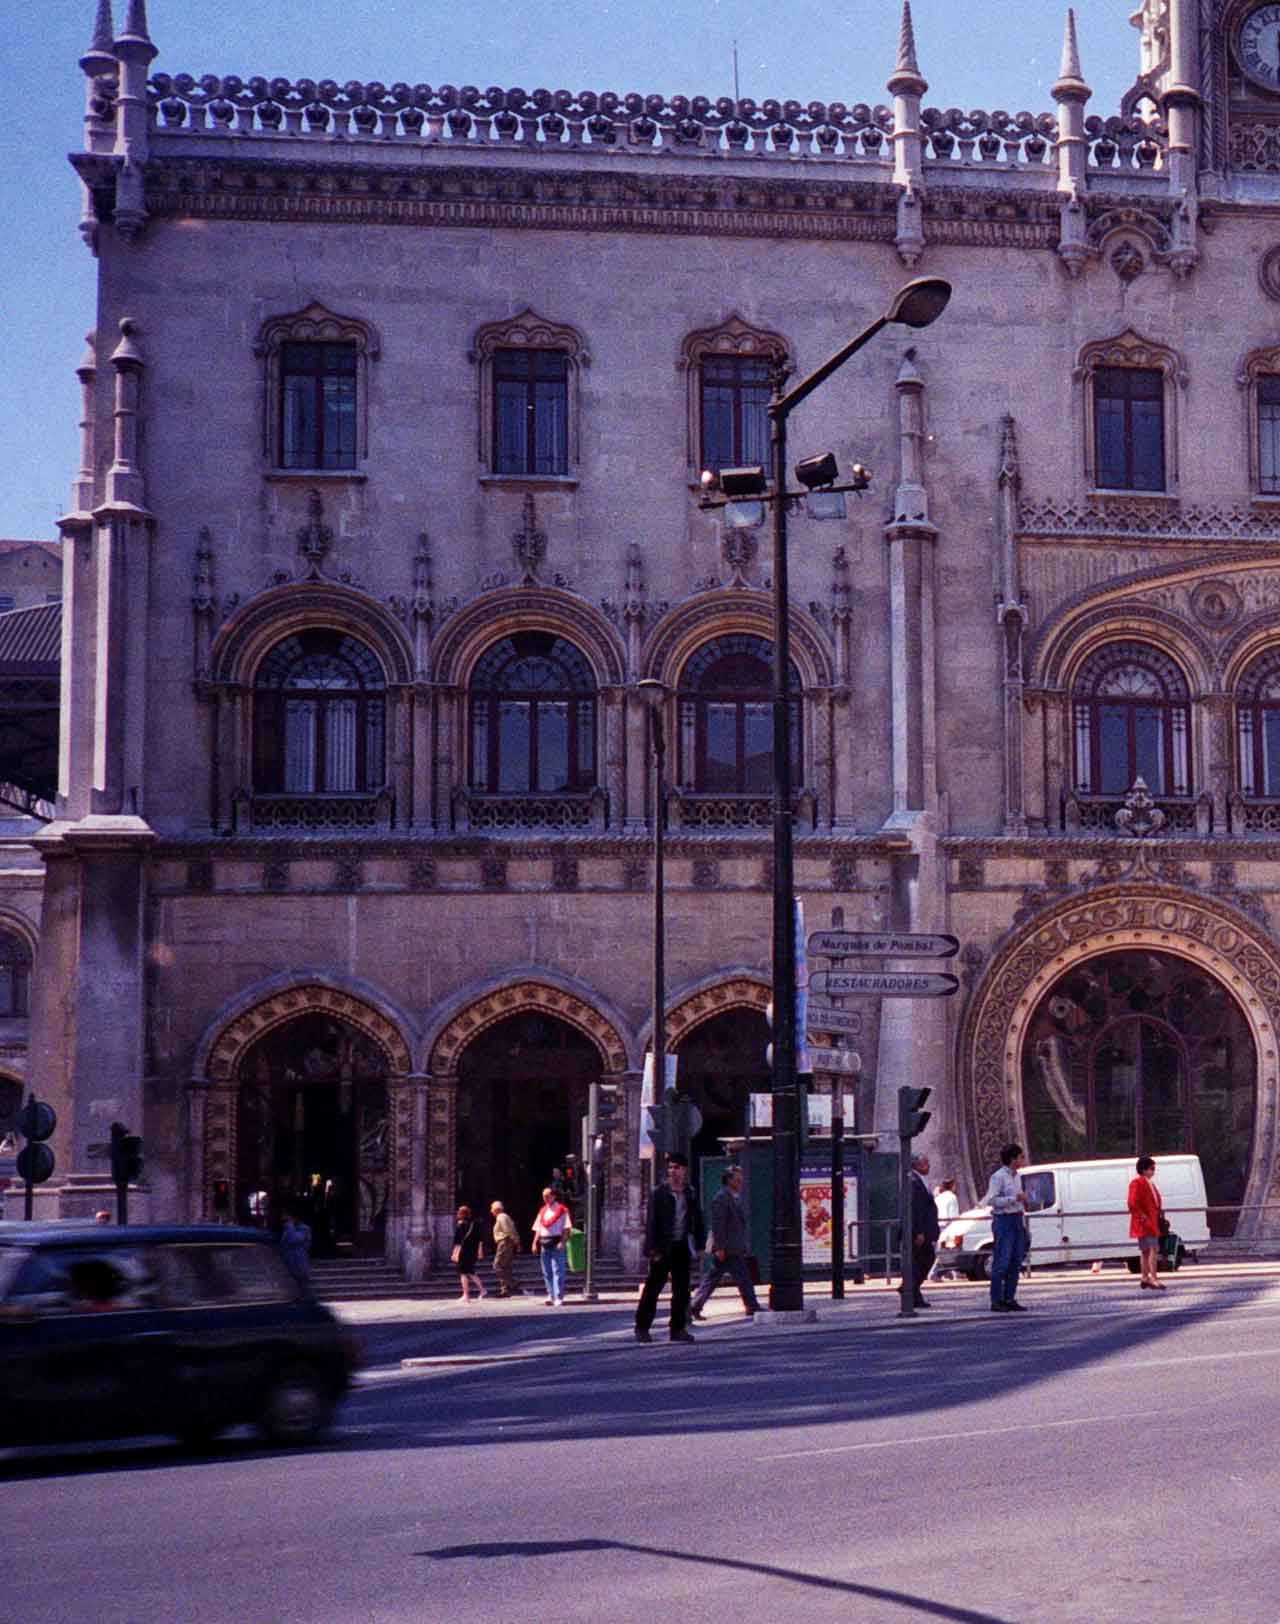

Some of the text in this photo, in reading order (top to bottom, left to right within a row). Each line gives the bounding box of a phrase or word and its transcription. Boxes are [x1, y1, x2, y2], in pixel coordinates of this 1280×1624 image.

[873, 939, 887, 950] de
[889, 940, 934, 951] Pombal
[825, 975, 929, 990] RESTAURADORES
